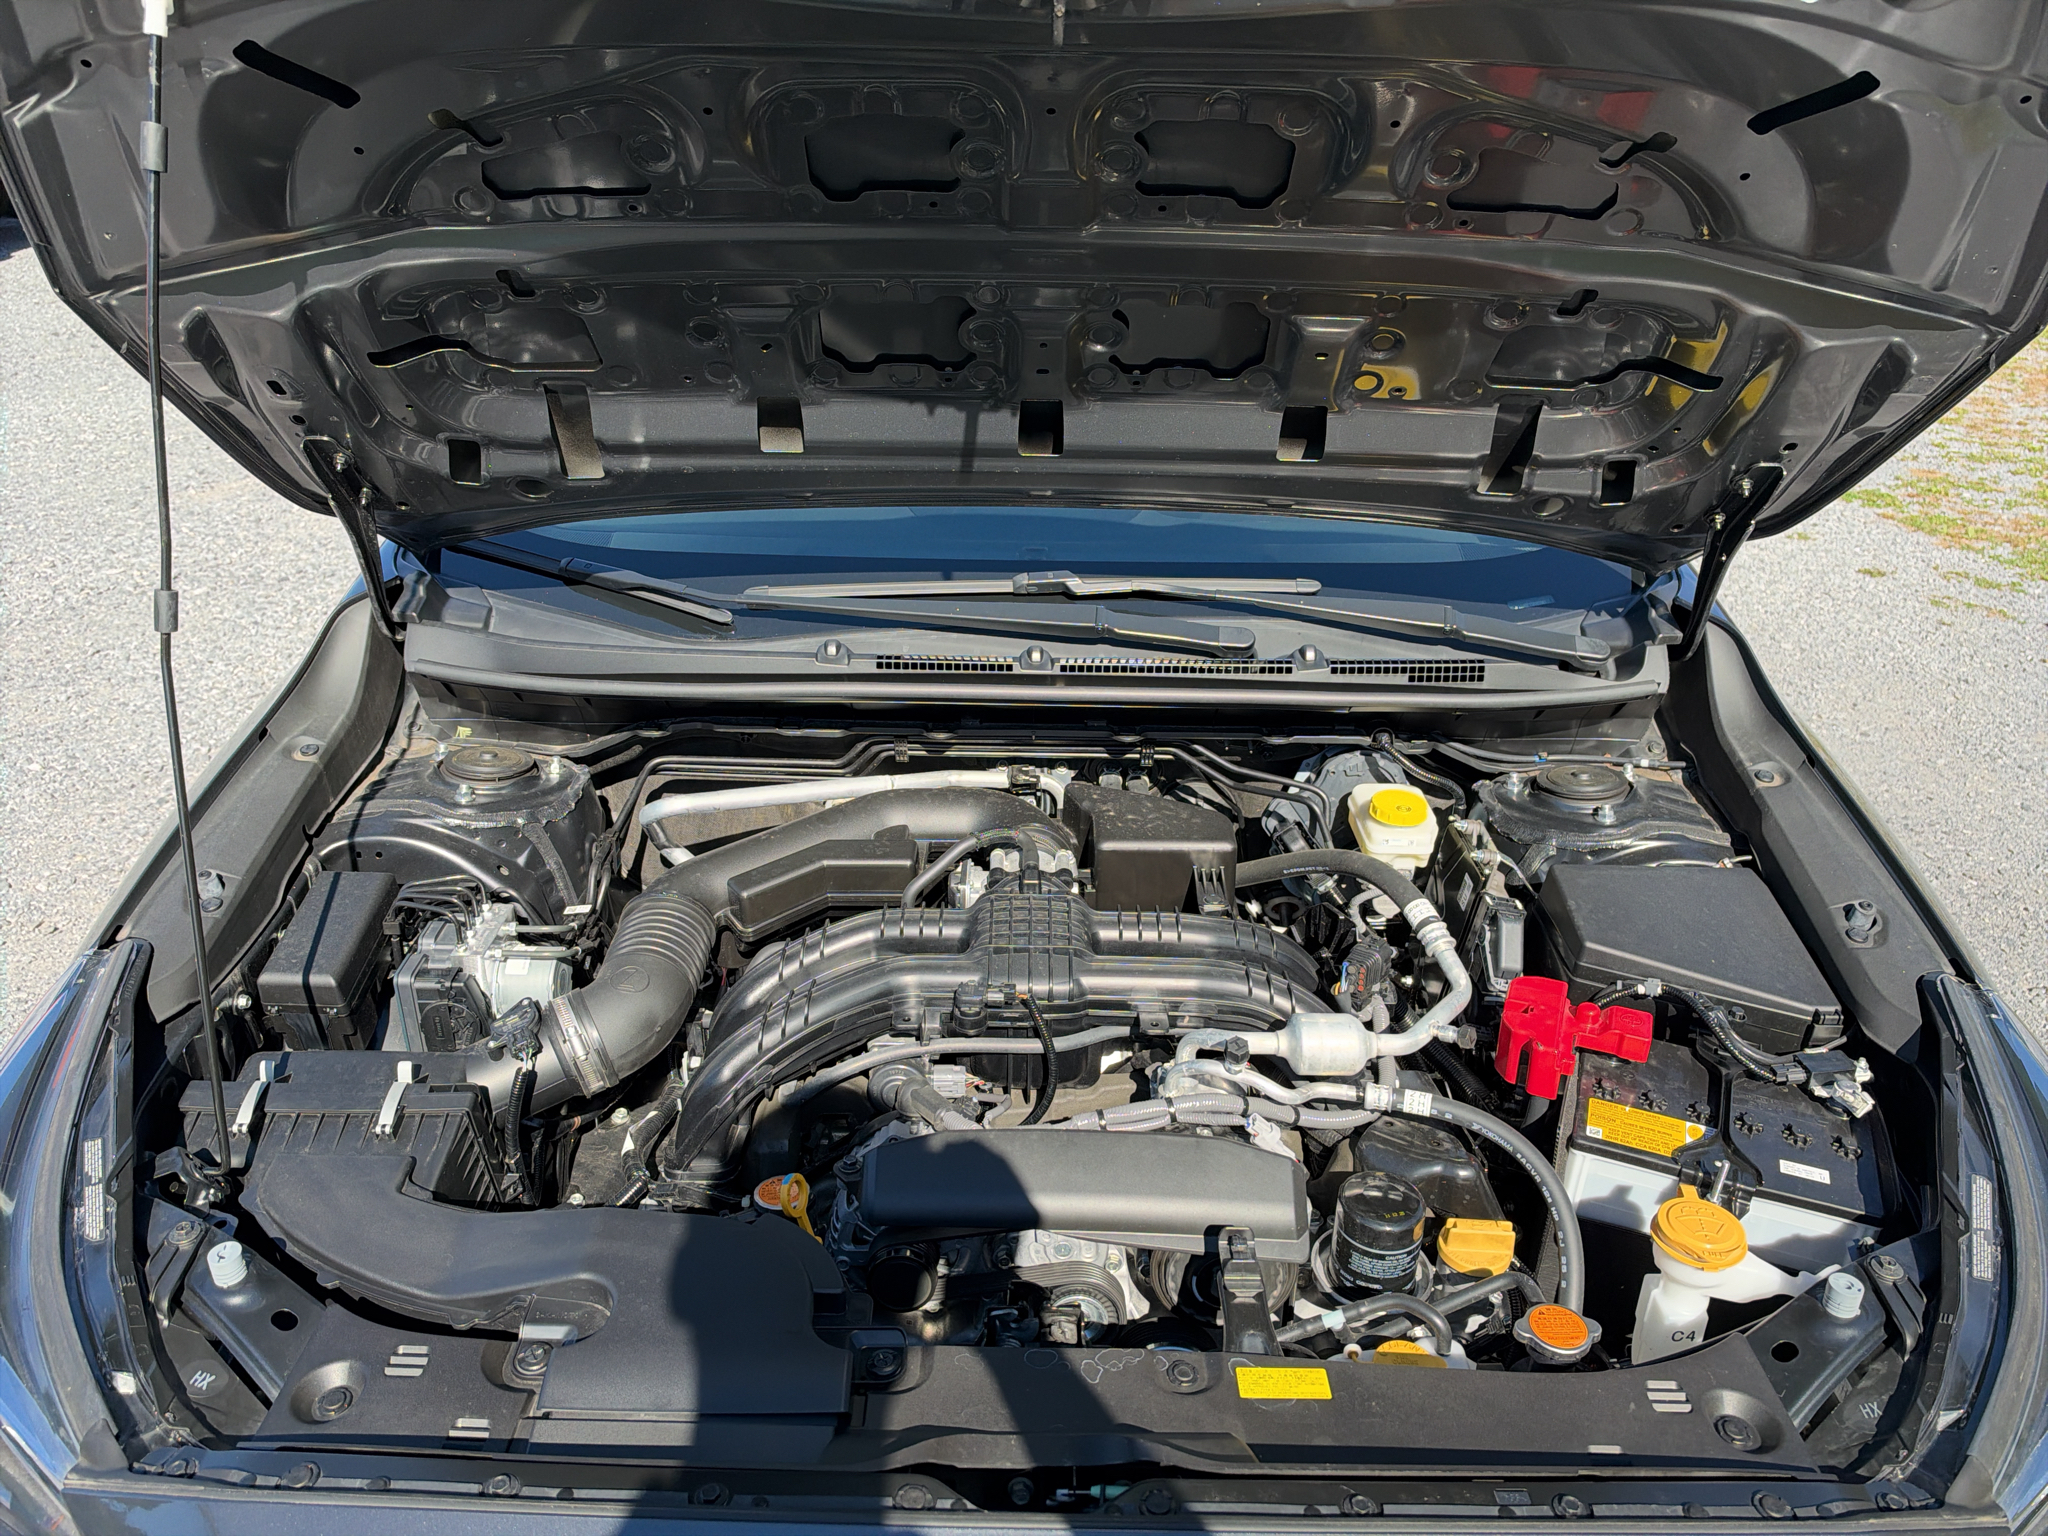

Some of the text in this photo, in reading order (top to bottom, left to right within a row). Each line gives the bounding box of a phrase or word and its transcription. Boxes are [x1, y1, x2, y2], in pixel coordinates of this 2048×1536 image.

[1592, 1099, 1617, 1109] DANGER
[1591, 1113, 1615, 1123] POISON
[1480, 1126, 1514, 1152] YOKOHAMA
[1671, 1330, 1696, 1342] C4
[189, 1370, 216, 1391] HX
[1859, 1401, 1883, 1419] HX
